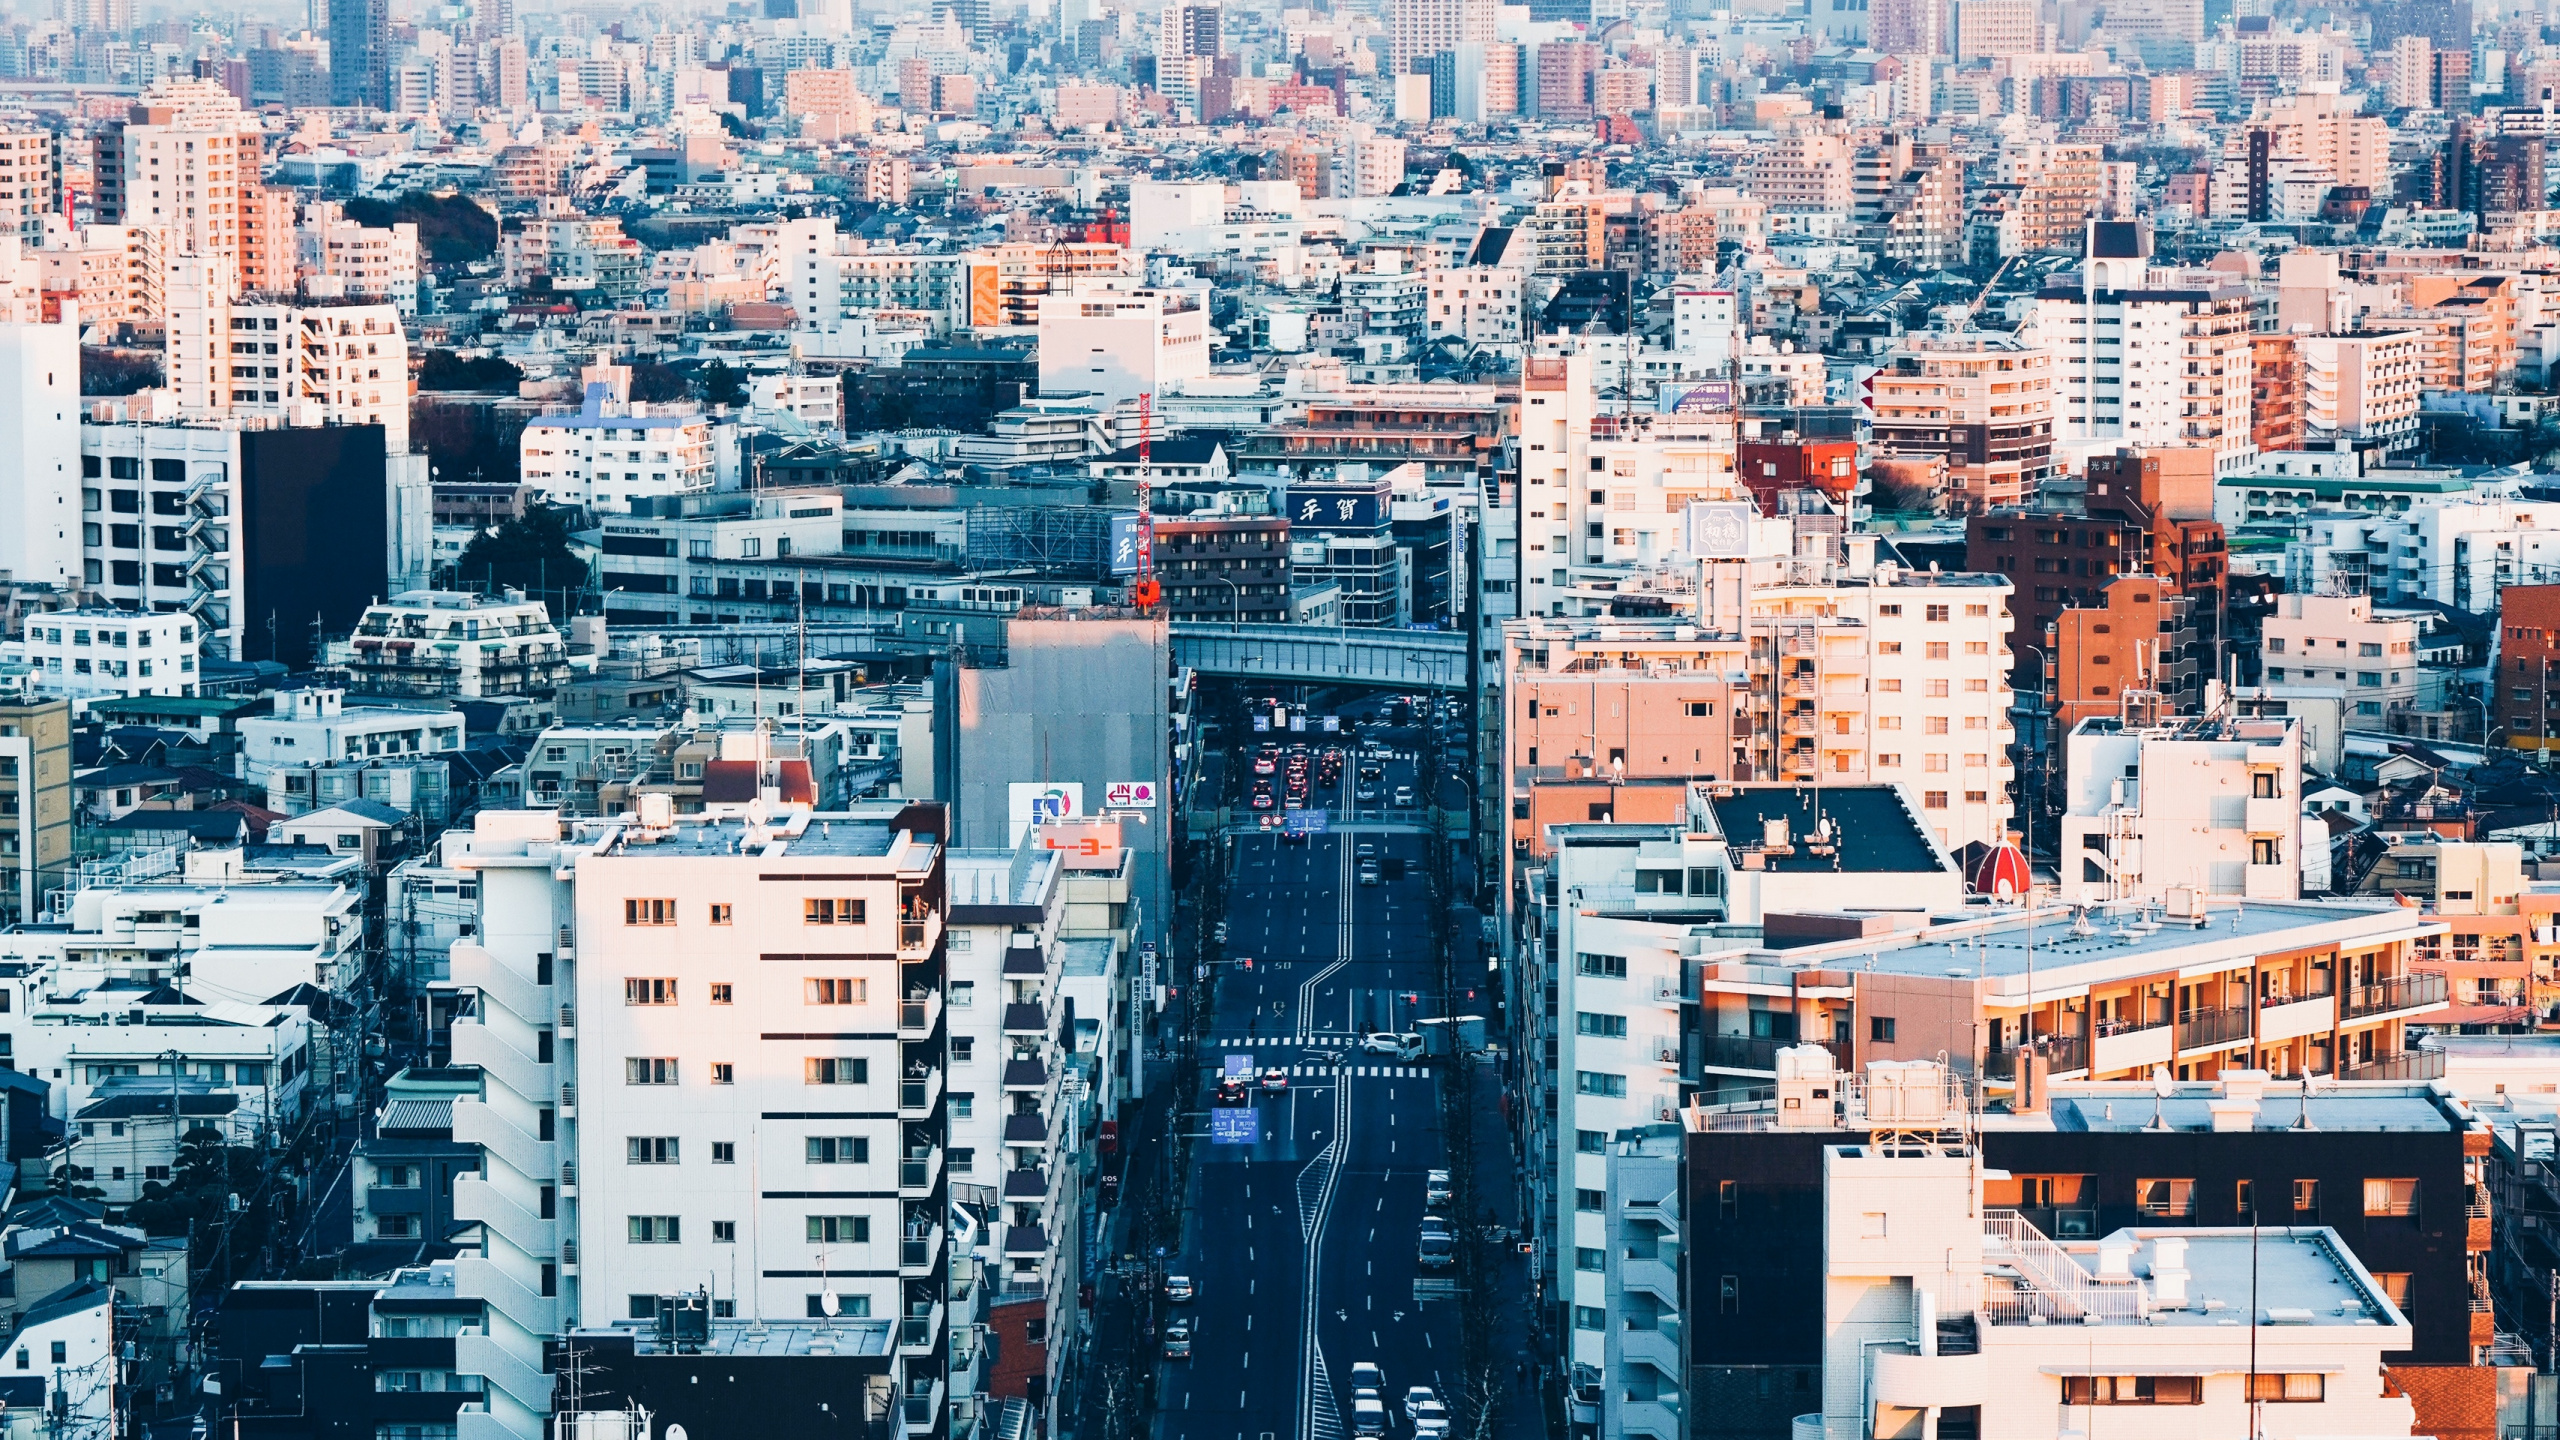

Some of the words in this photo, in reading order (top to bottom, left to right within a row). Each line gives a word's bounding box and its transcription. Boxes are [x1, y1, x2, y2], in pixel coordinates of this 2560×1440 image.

[2091, 461, 2110, 470] 光洋
[2144, 461, 2158, 472] 光洋
[1300, 498, 1358, 521] 平賀
[1704, 522, 1737, 539] 初穂
[1117, 784, 1130, 794] IN
[1047, 838, 1112, 856] トーヨー
